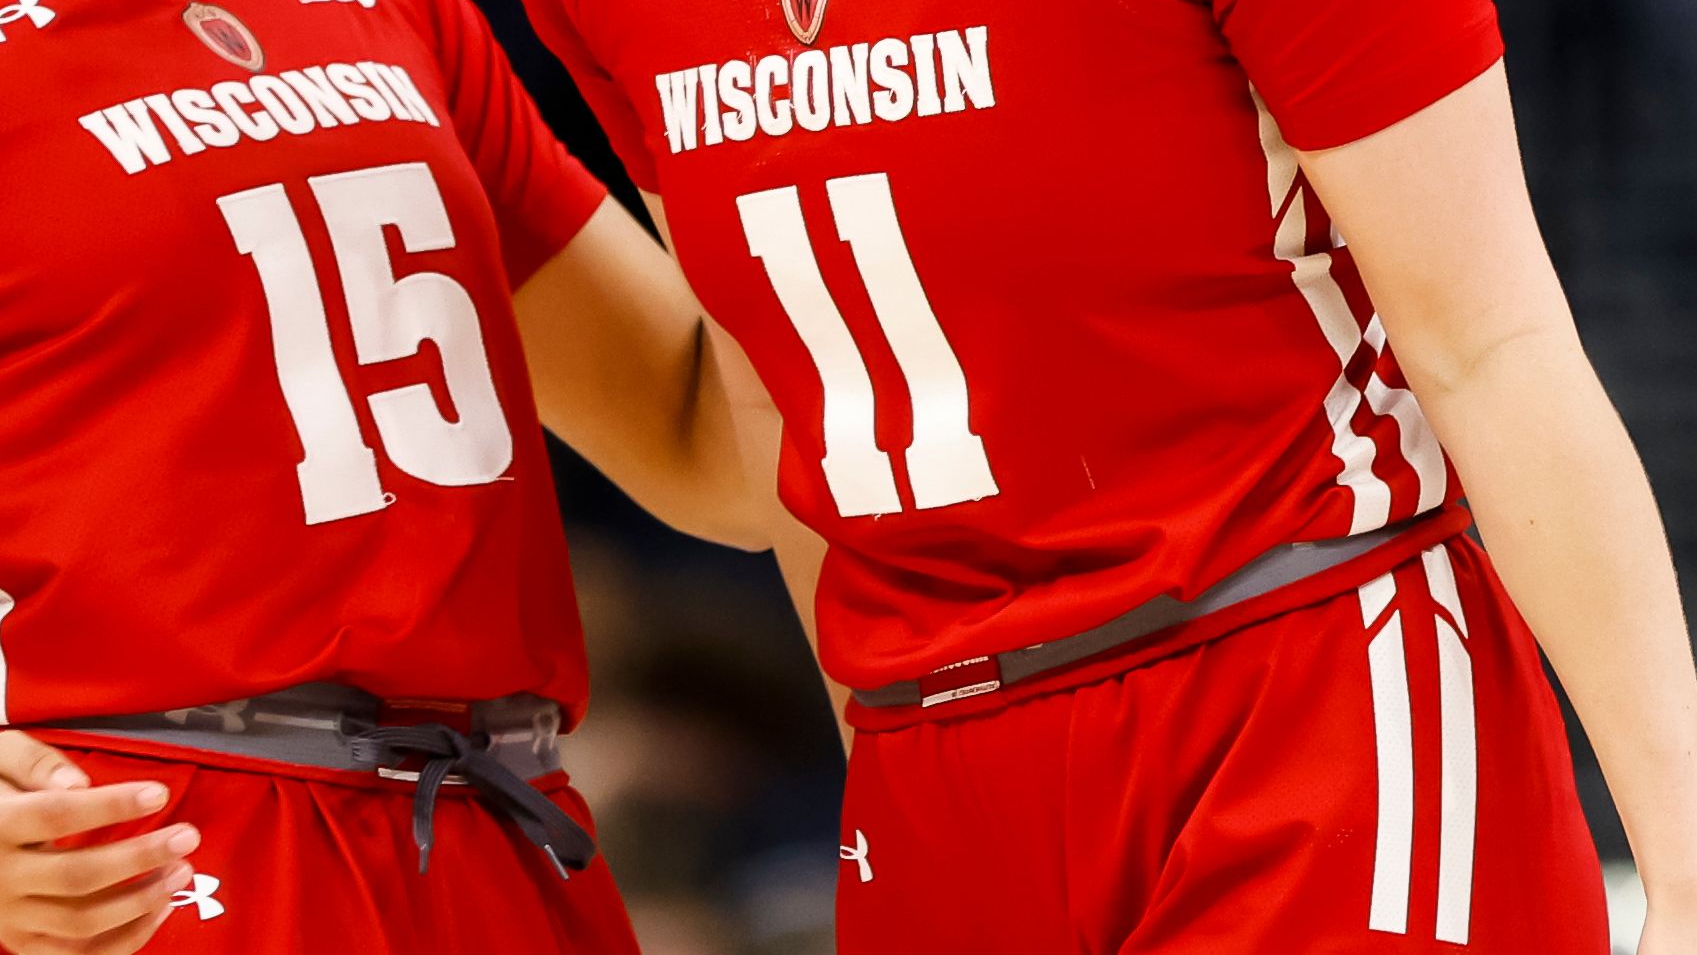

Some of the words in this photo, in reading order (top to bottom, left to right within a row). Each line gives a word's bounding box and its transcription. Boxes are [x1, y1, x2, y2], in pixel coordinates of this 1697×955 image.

[79, 61, 440, 174] WISCONSIN
[656, 26, 996, 154] WISCONSIN
[216, 162, 513, 525] 15
[736, 173, 999, 517] 11
